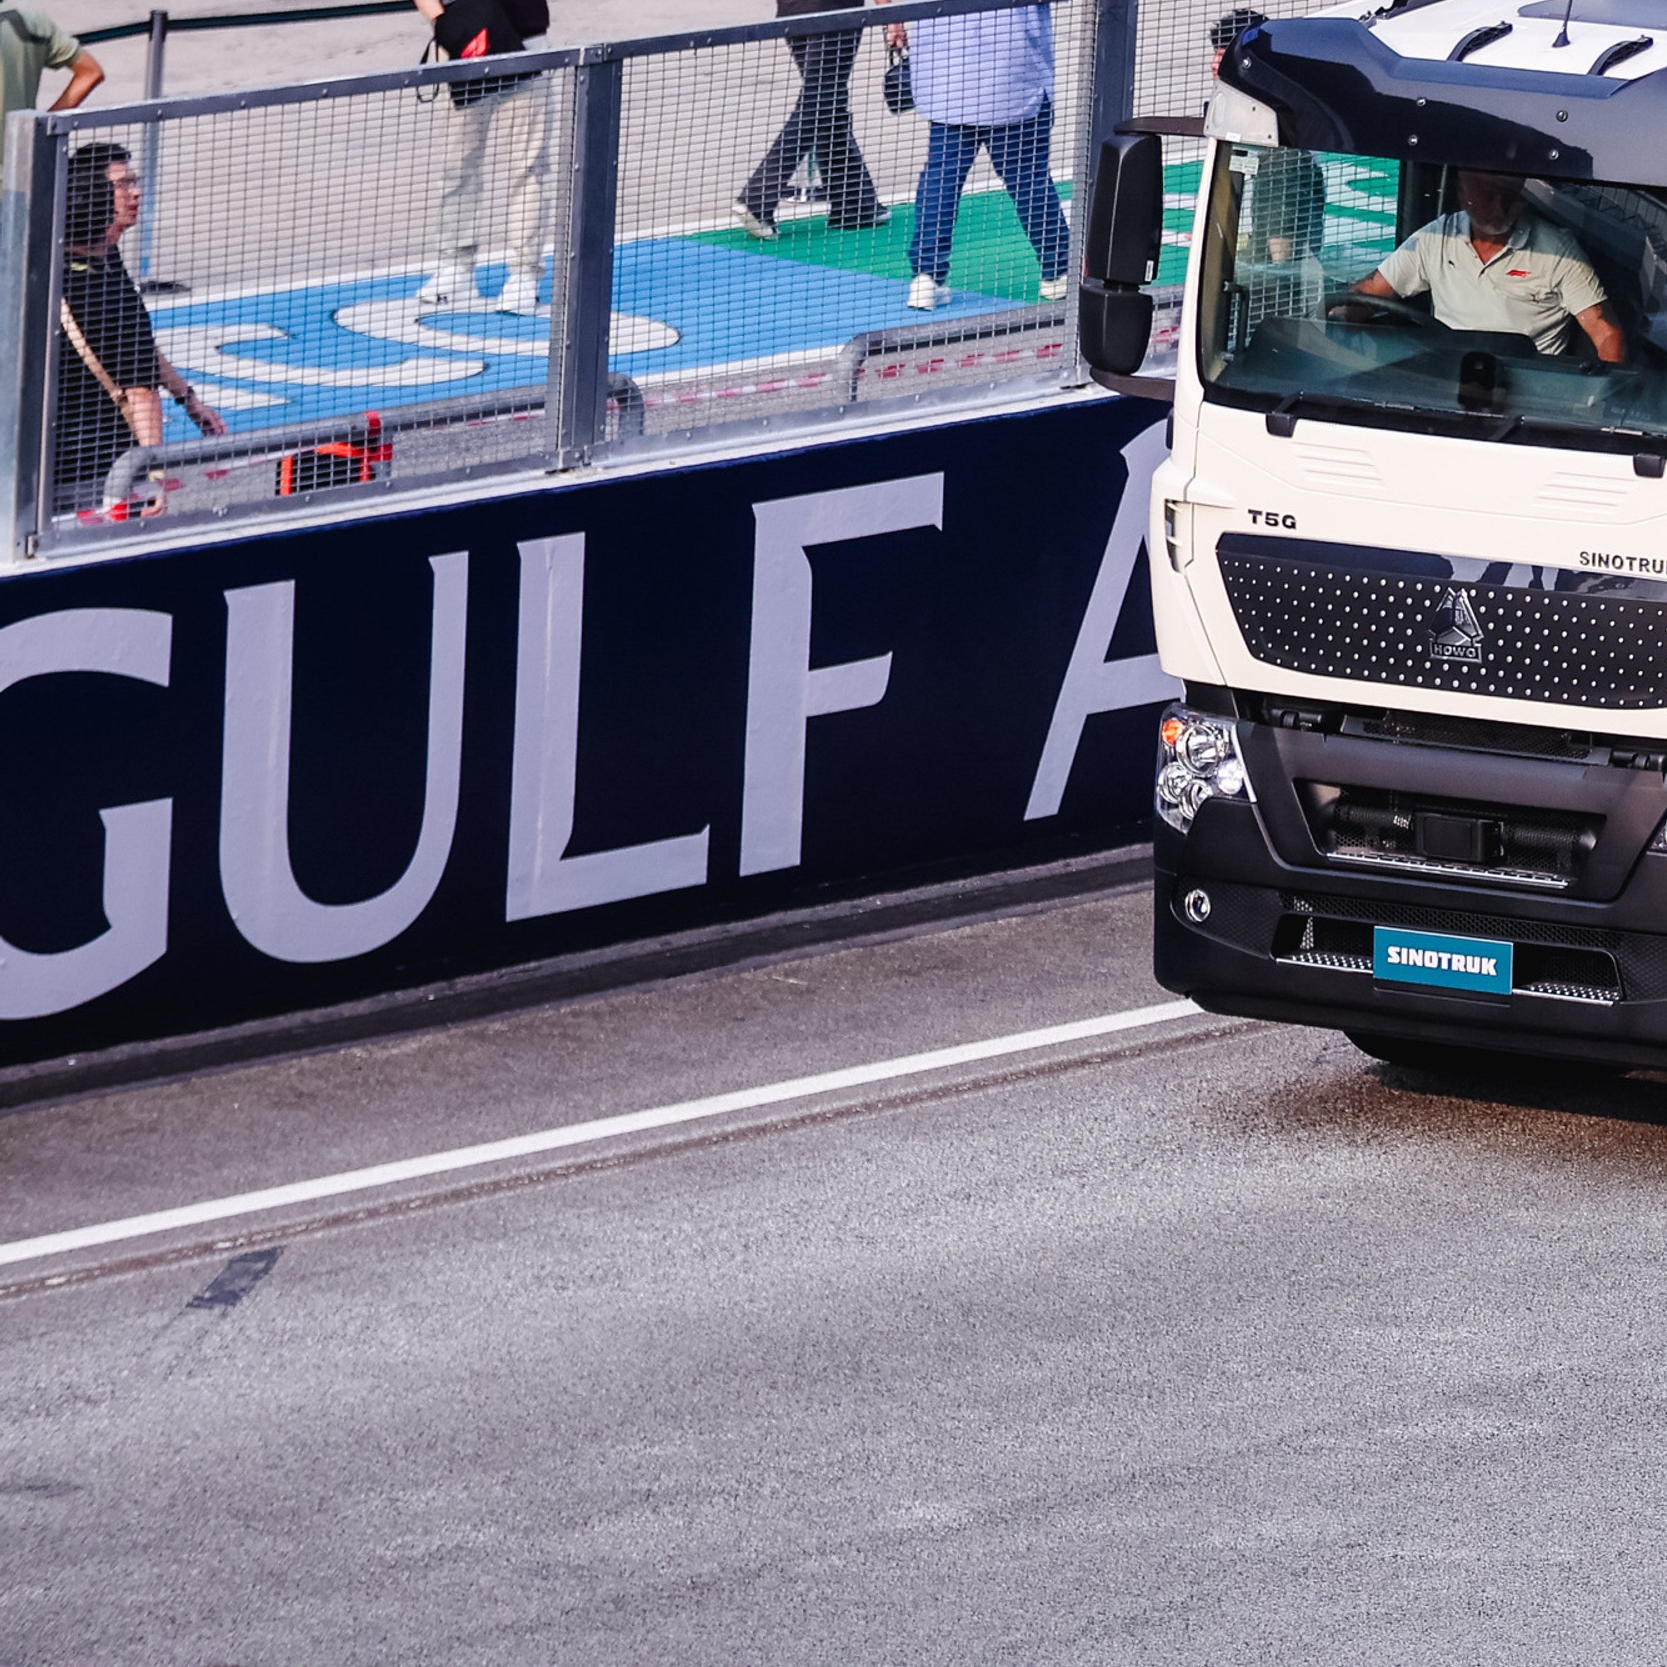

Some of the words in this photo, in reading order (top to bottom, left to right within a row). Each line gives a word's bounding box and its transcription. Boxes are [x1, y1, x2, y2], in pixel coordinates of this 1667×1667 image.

[1247, 508, 1297, 530] T5G
[1433, 644, 1477, 659] HOWO
[0, 472, 943, 1020] GULF
[1387, 945, 1498, 976] SINOTRUK
